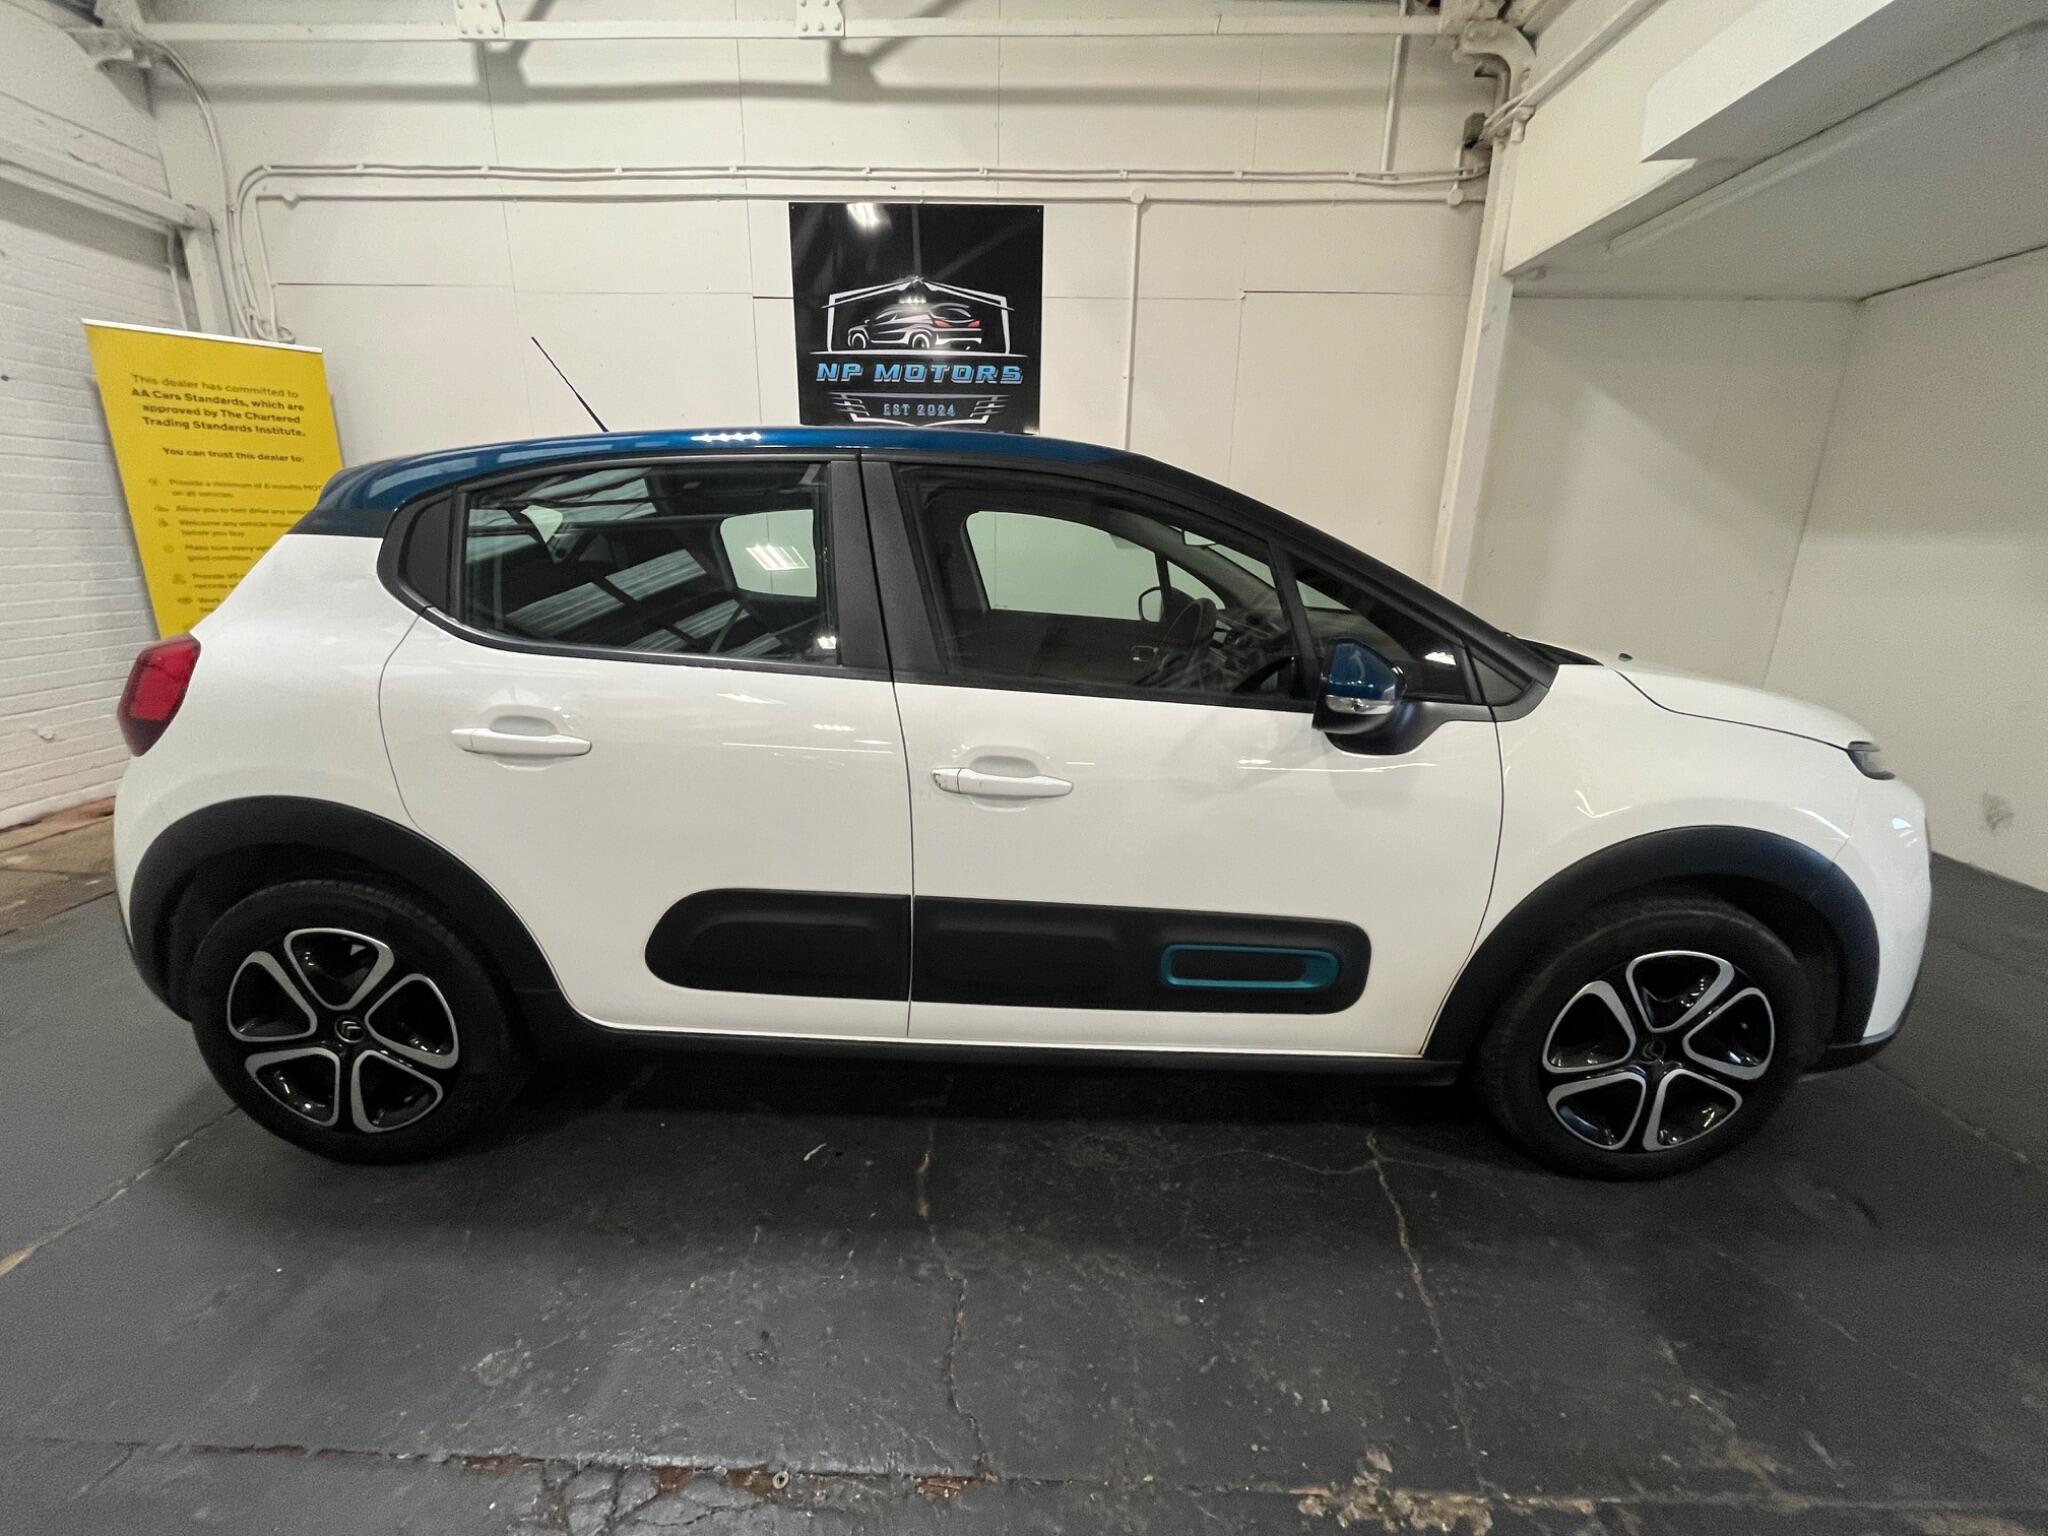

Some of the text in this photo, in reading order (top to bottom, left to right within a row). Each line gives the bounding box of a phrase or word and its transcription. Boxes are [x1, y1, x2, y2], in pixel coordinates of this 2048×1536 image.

[815, 363, 1024, 384] NP MOTORS
[132, 374, 298, 398] This dealer has committed to
[132, 388, 304, 412] AA Cars Standards, which are
[883, 403, 956, 417] EST 2024
[142, 404, 300, 423] approved by The Chartered
[142, 416, 306, 437] Trading Standards Institute.
[162, 447, 183, 456] You
[208, 450, 234, 459] trust
[236, 452, 256, 460] this
[257, 454, 289, 462] dealer
